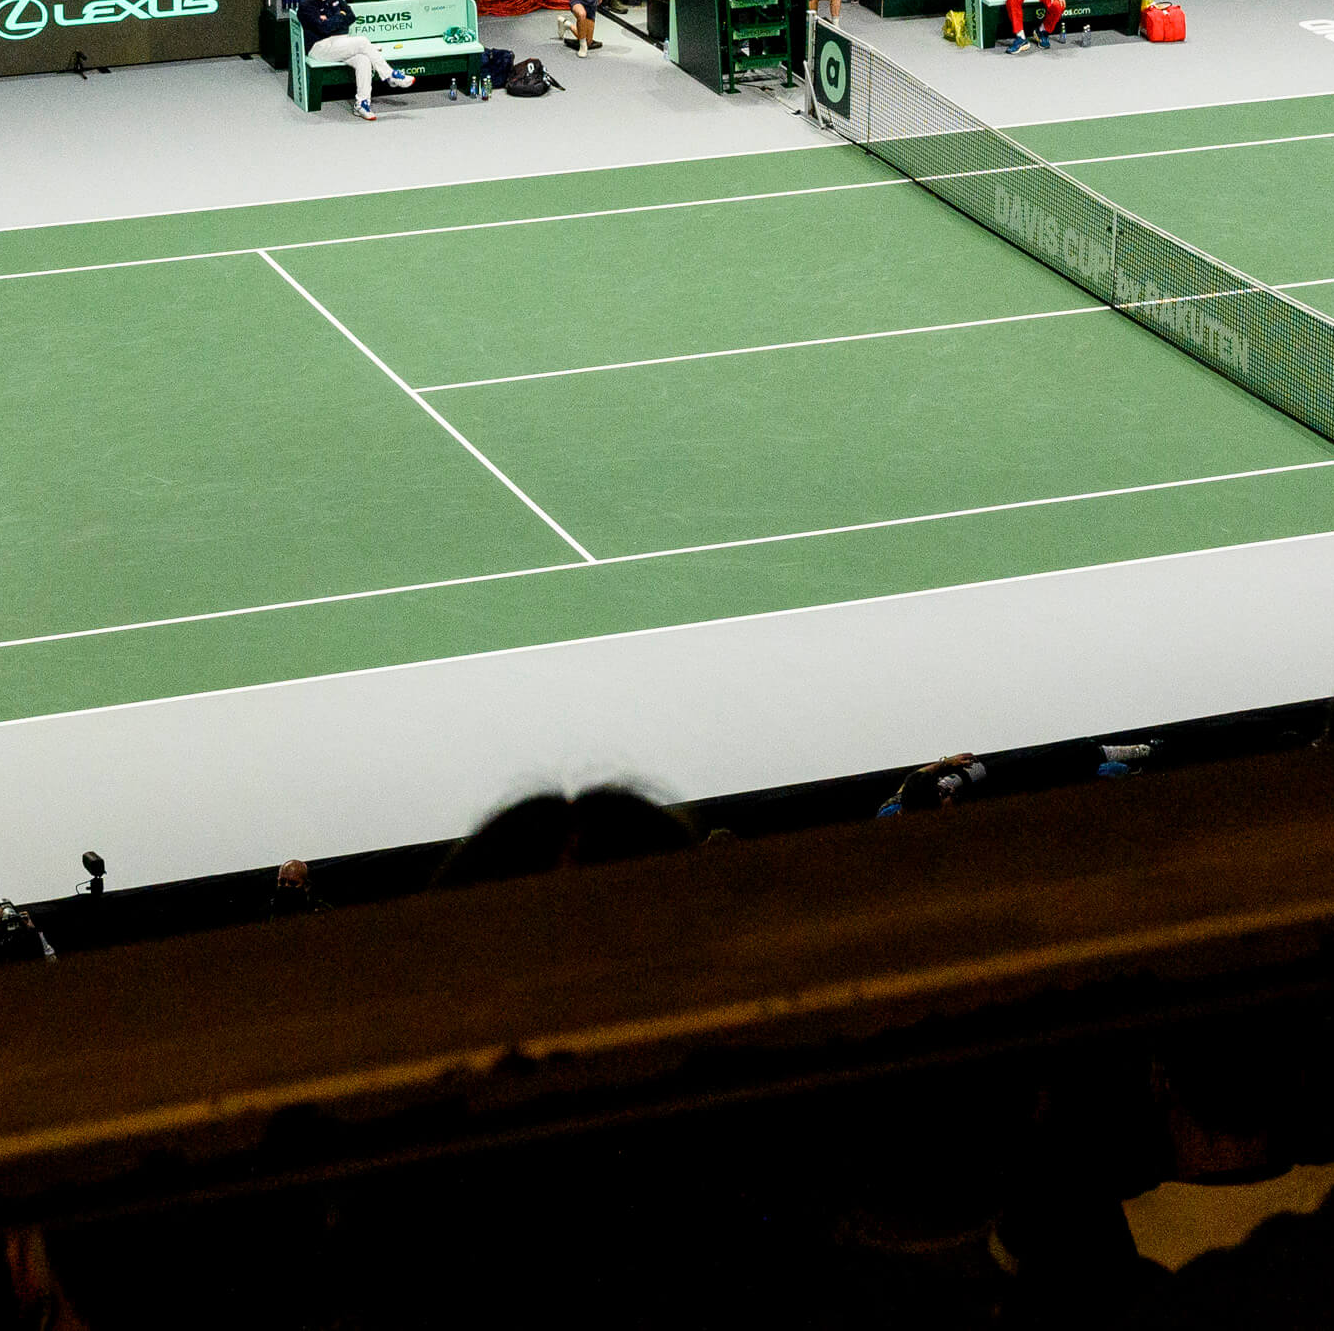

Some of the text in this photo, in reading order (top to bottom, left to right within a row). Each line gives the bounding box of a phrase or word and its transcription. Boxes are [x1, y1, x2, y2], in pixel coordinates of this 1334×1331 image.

[354, 21, 413, 34] FAN TOKEN
[994, 183, 1060, 258] DAVIS
[1065, 226, 1109, 282] CUP
[1145, 278, 1250, 374] RAKUTEN
